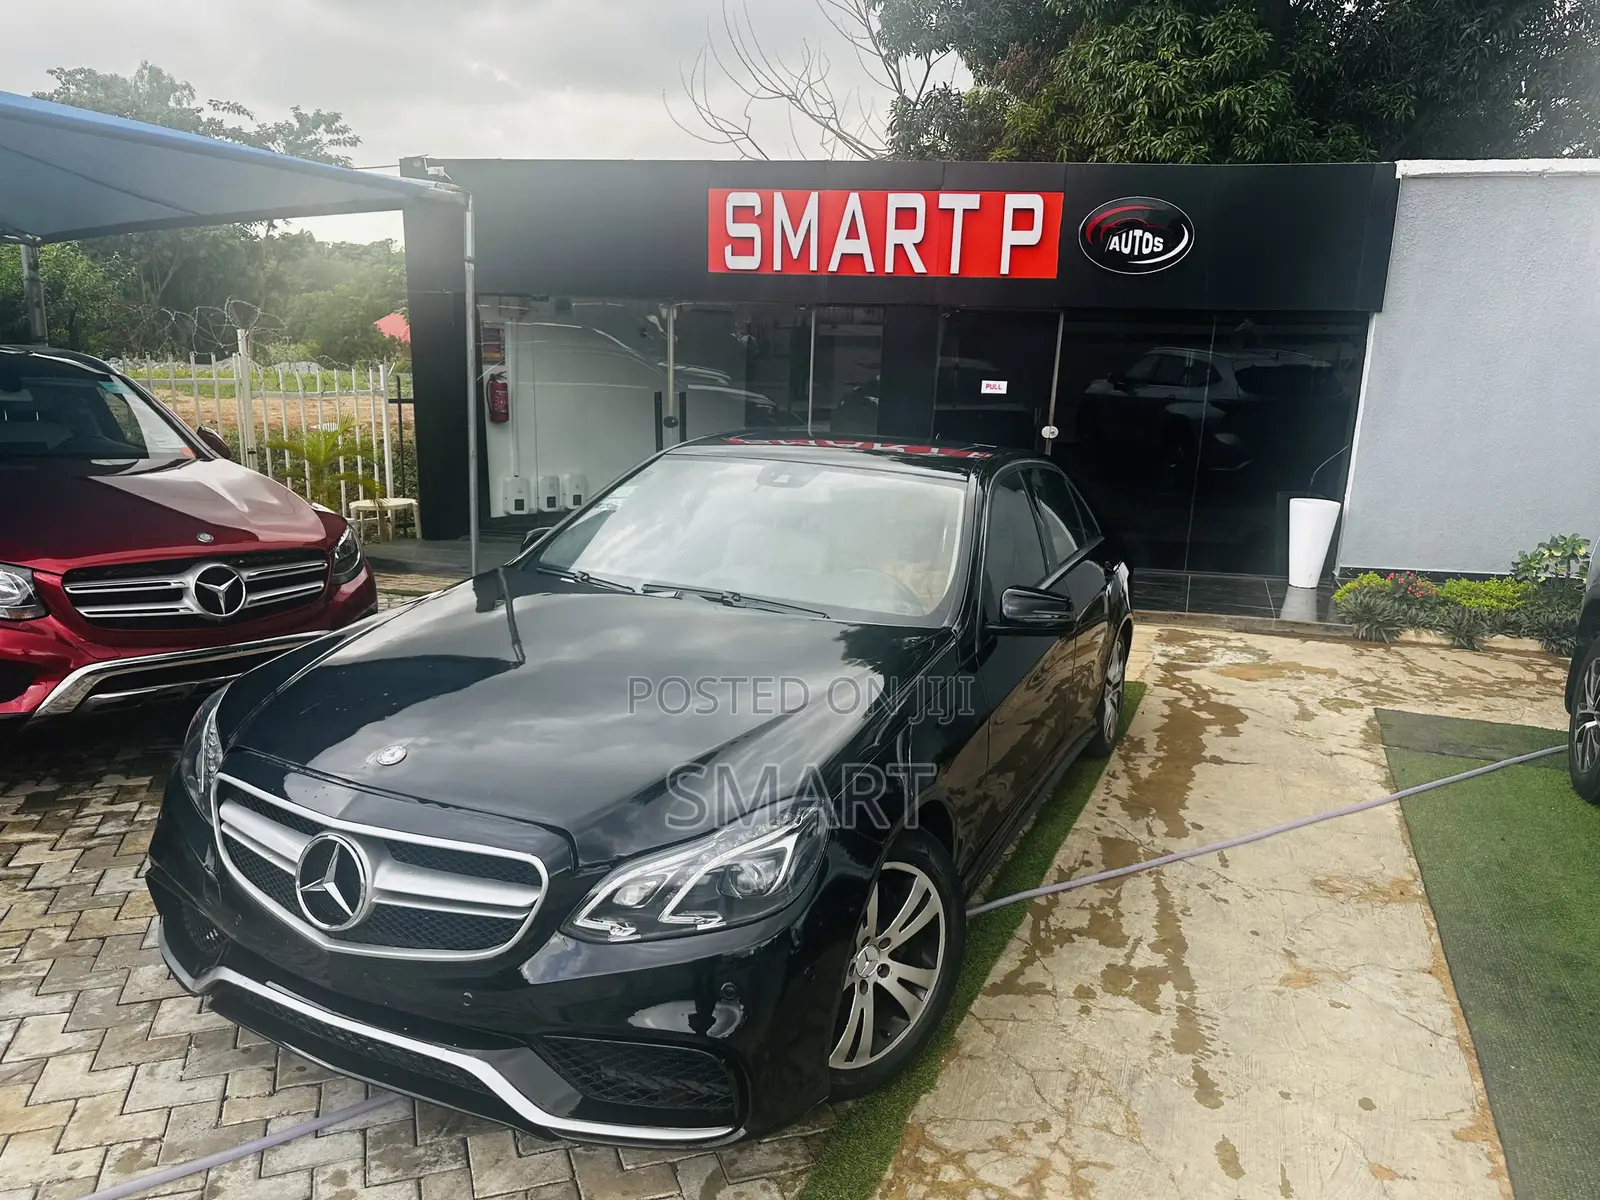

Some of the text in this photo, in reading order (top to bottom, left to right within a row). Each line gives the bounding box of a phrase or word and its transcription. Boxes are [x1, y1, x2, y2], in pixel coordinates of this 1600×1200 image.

[724, 191, 1045, 275] SMART P
[1108, 229, 1164, 256] AUTOS
[985, 383, 1003, 391] PULL
